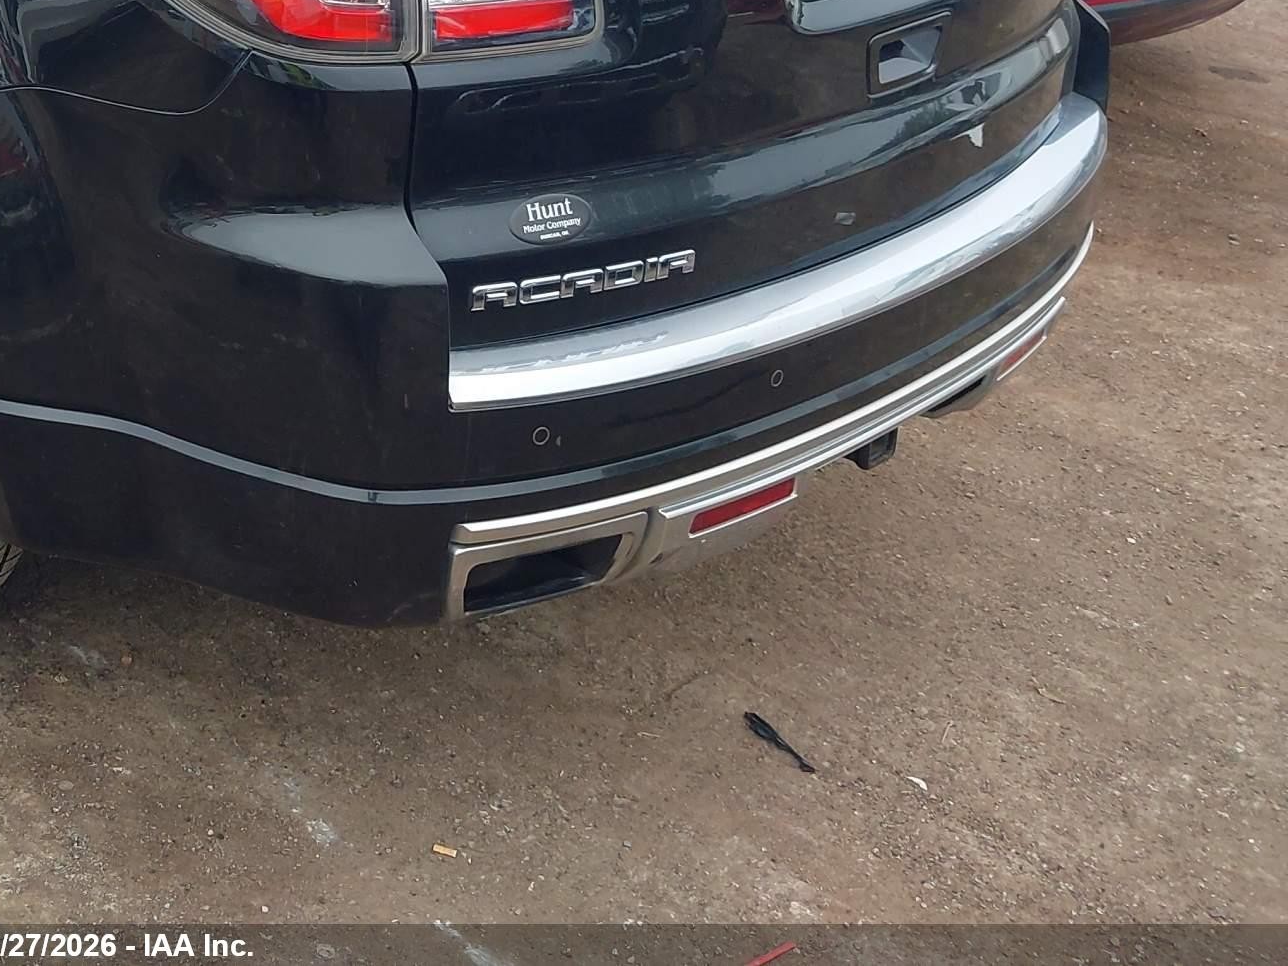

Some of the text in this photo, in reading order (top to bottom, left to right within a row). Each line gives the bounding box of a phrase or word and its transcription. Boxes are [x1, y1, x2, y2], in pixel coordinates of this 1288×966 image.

[526, 197, 573, 222] Hunt
[523, 218, 581, 234] Motor Company
[470, 249, 696, 311] ACADIA
